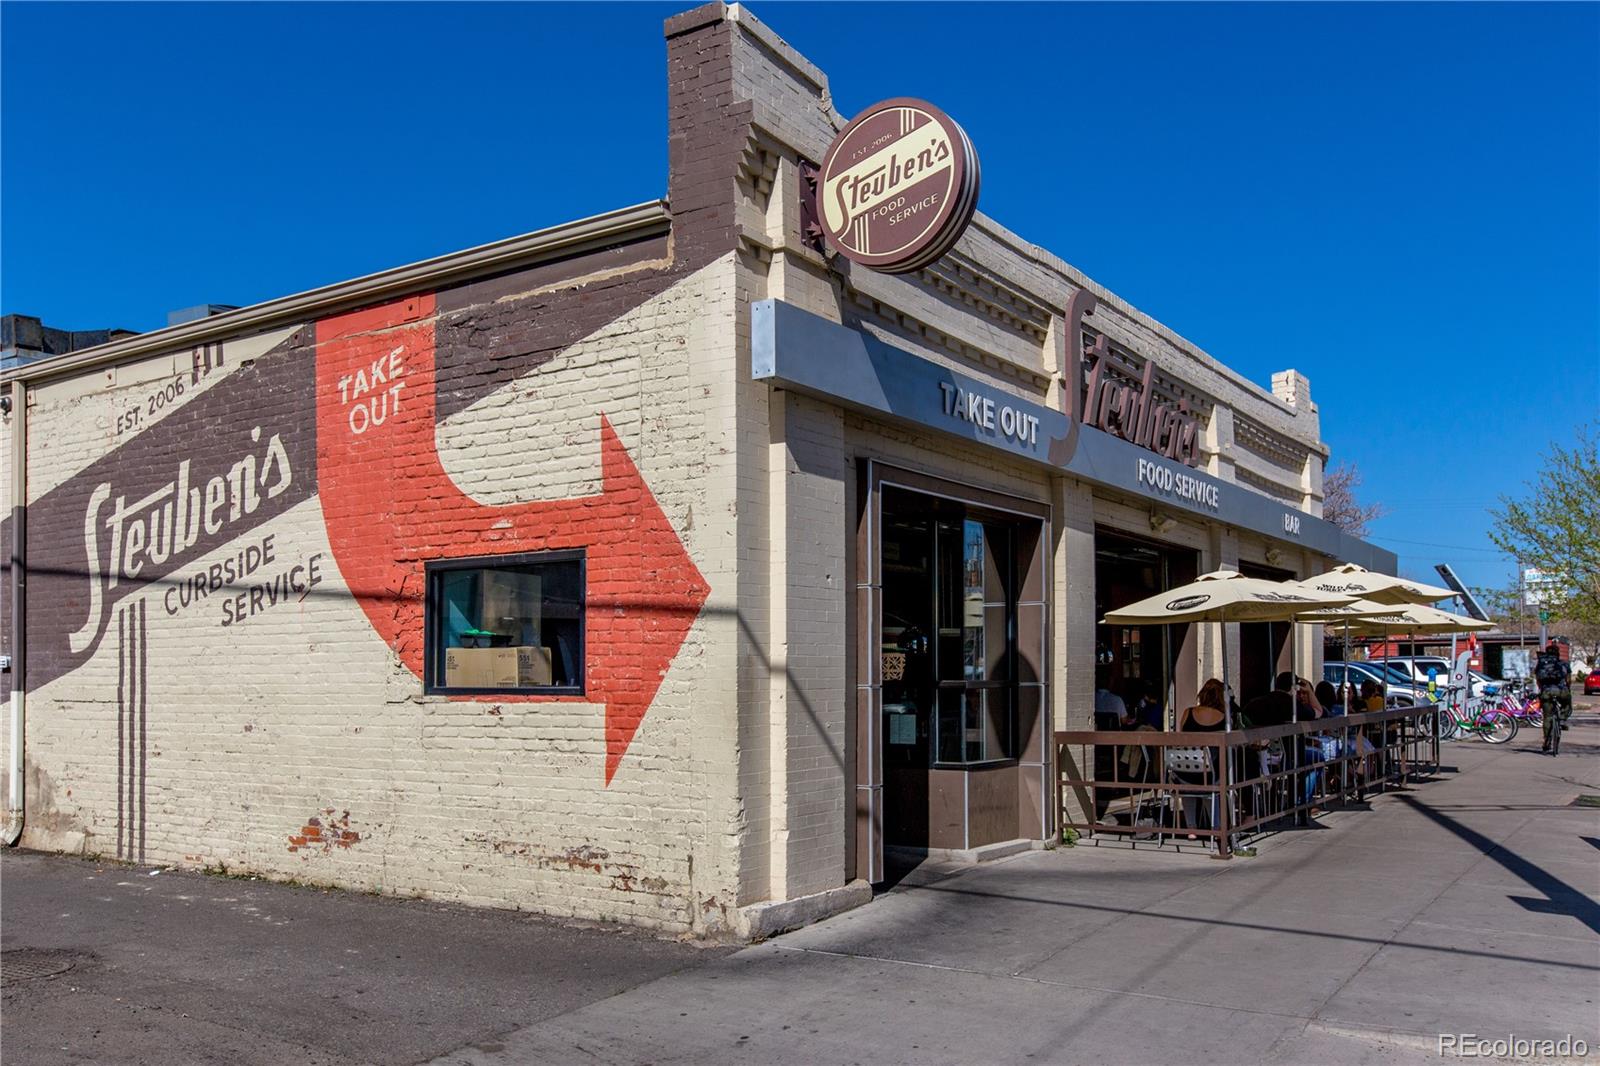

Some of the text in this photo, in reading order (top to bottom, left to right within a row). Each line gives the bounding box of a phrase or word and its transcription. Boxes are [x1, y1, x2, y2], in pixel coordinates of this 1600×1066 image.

[834, 138, 950, 239] Steuben's
[872, 196, 906, 221] FOOD
[889, 192, 939, 226] SERVICE
[338, 345, 405, 404] TAKE
[116, 375, 186, 435] EST. 2006
[349, 382, 407, 435] OUT
[939, 380, 1040, 445] TAKE OUT
[1138, 458, 1219, 508] FOOD SERVICE
[69, 425, 293, 653] Steuben's
[1284, 513, 1300, 535] BAR
[165, 533, 277, 615] CURBSIDE
[221, 553, 323, 627] SERVICE
